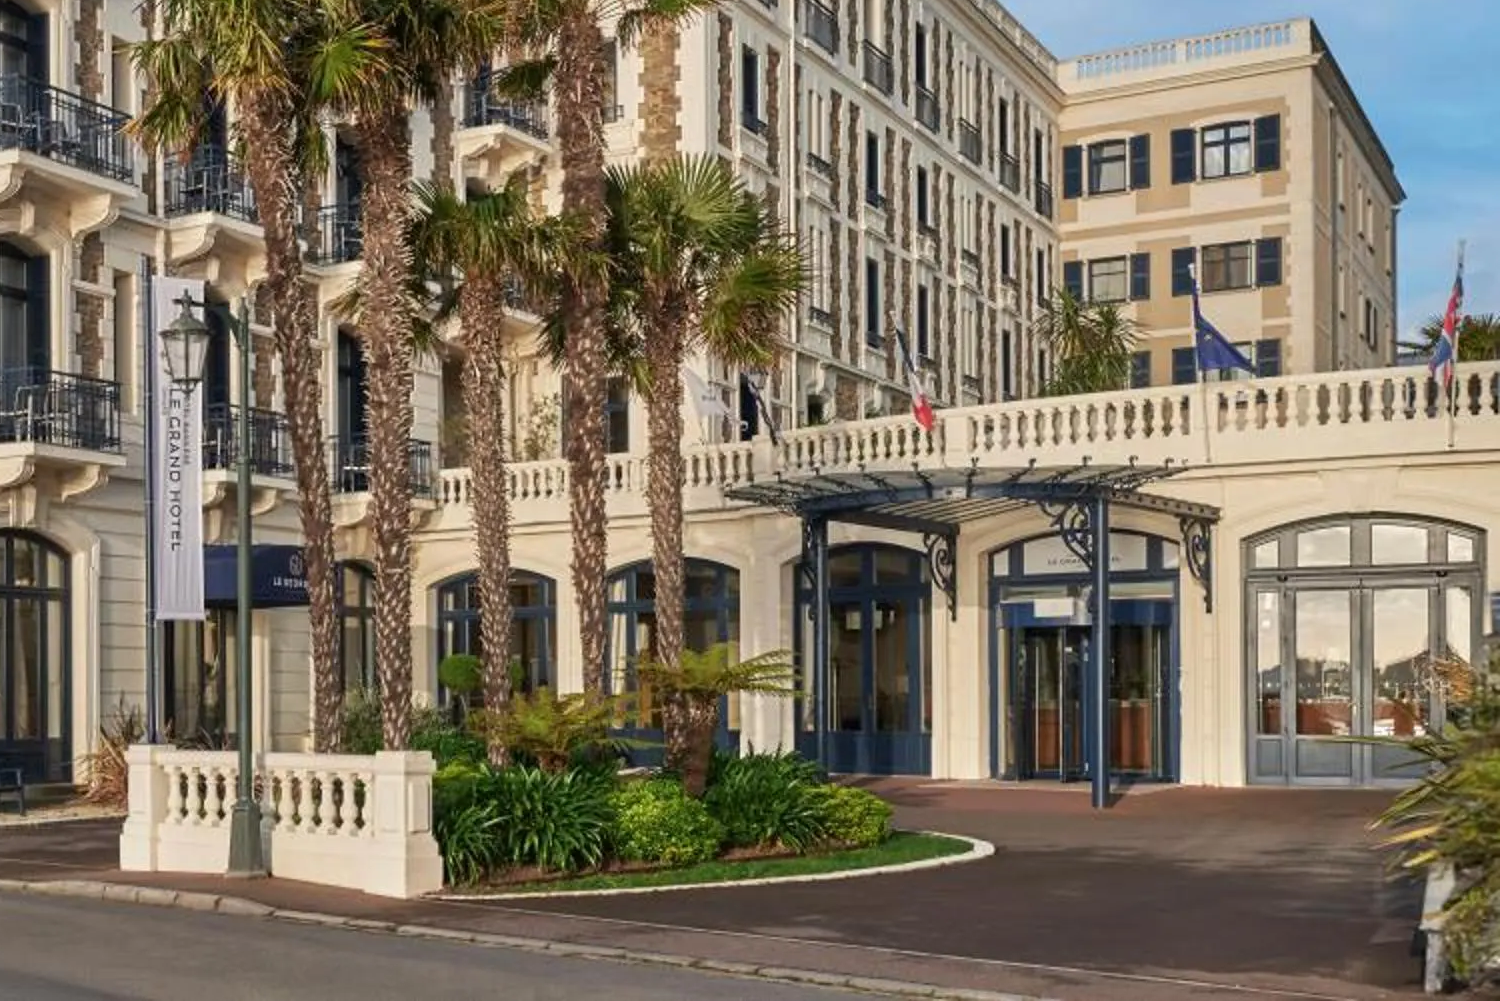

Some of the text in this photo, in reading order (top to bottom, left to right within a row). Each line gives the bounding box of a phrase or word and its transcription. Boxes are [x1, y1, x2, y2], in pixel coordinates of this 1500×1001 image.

[168, 388, 181, 551] LE GRAND HOTEL
